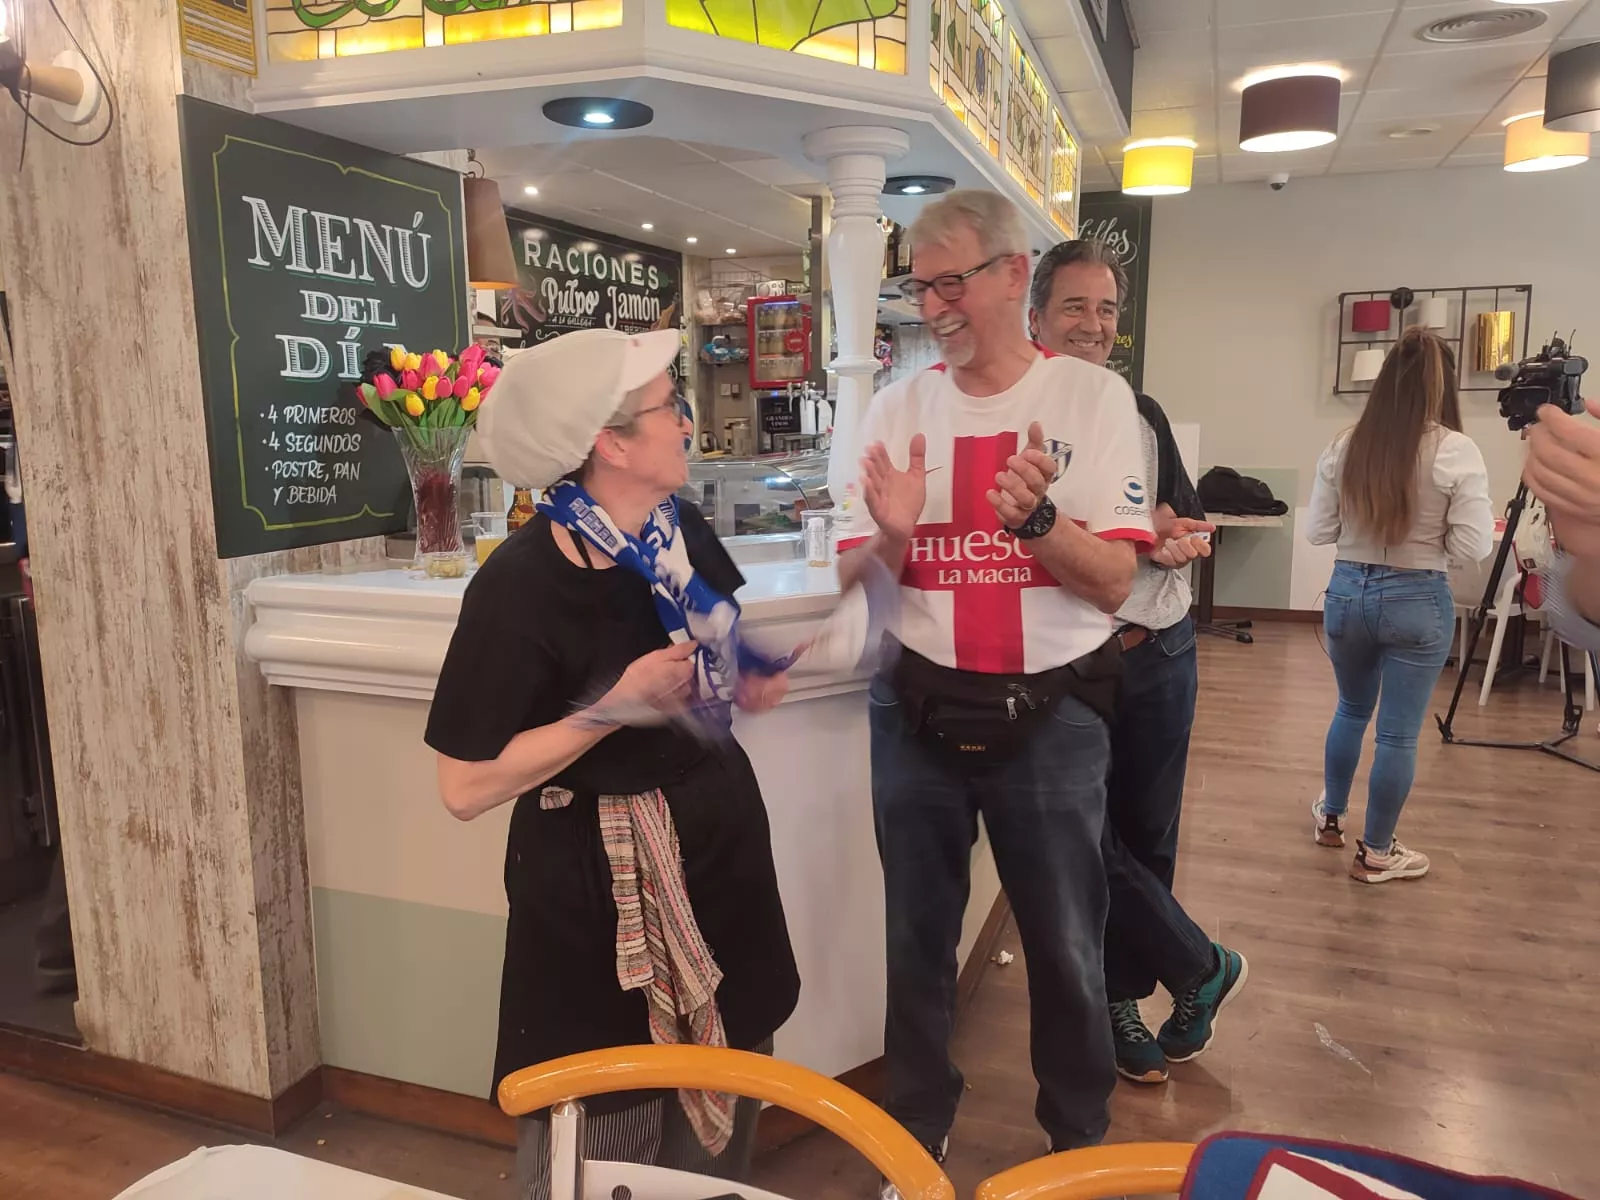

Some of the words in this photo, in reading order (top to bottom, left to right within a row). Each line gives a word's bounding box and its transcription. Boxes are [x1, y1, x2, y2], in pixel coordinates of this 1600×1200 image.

[242, 195, 432, 289] MENÚ
[523, 239, 660, 290] RACIONES
[299, 289, 398, 327] DEL
[605, 286, 660, 329] Jamón
[275, 327, 412, 380] DÍ
[283, 405, 356, 425] PRIMEROS
[286, 432, 361, 453] SEGUNDOS
[333, 462, 360, 481] PAN
[273, 486, 283, 506] Y
[286, 485, 337, 504] BEBIDA
